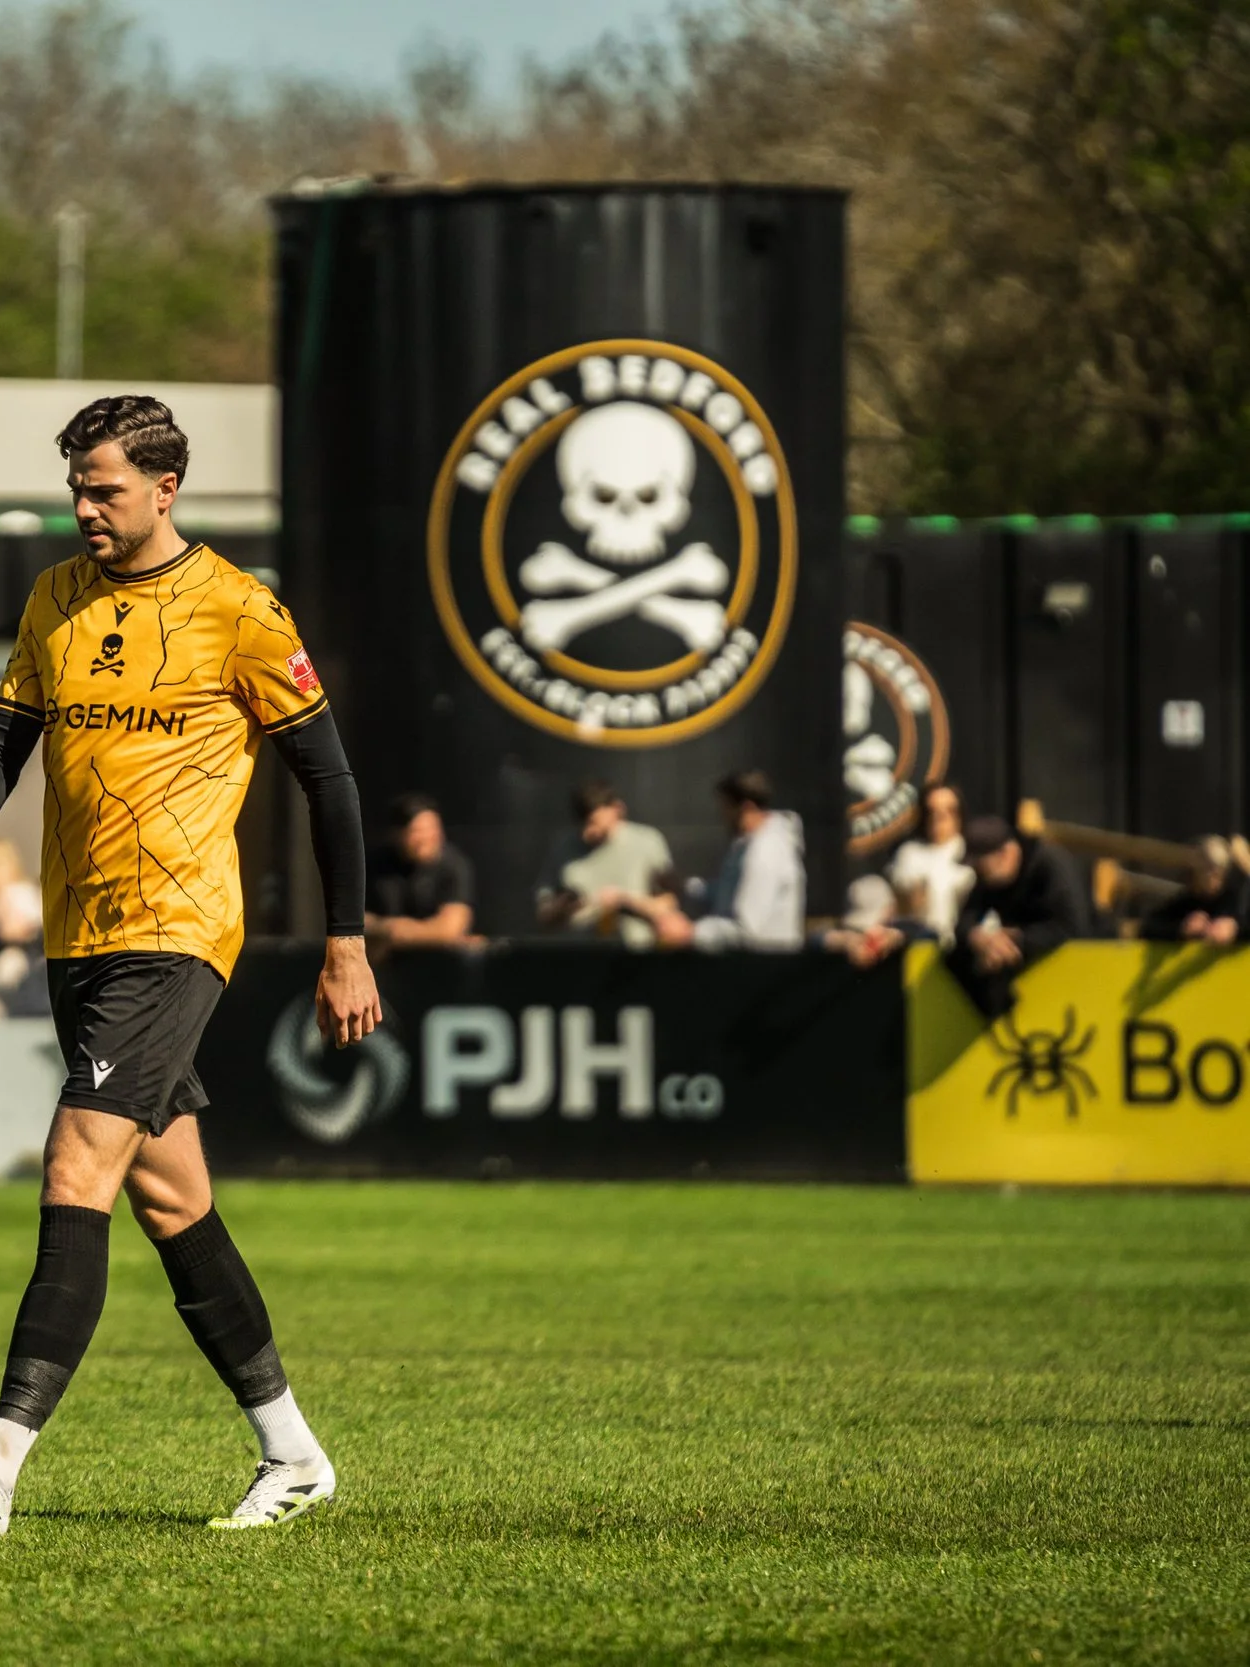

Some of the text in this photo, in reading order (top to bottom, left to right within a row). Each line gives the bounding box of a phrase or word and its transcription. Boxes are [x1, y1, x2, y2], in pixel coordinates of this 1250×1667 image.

[457, 354, 777, 494] REAL BEDFORD
[66, 703, 187, 736] GEMINI
[424, 1006, 653, 1118] PJH
[1124, 1020, 1250, 1107] Bo
